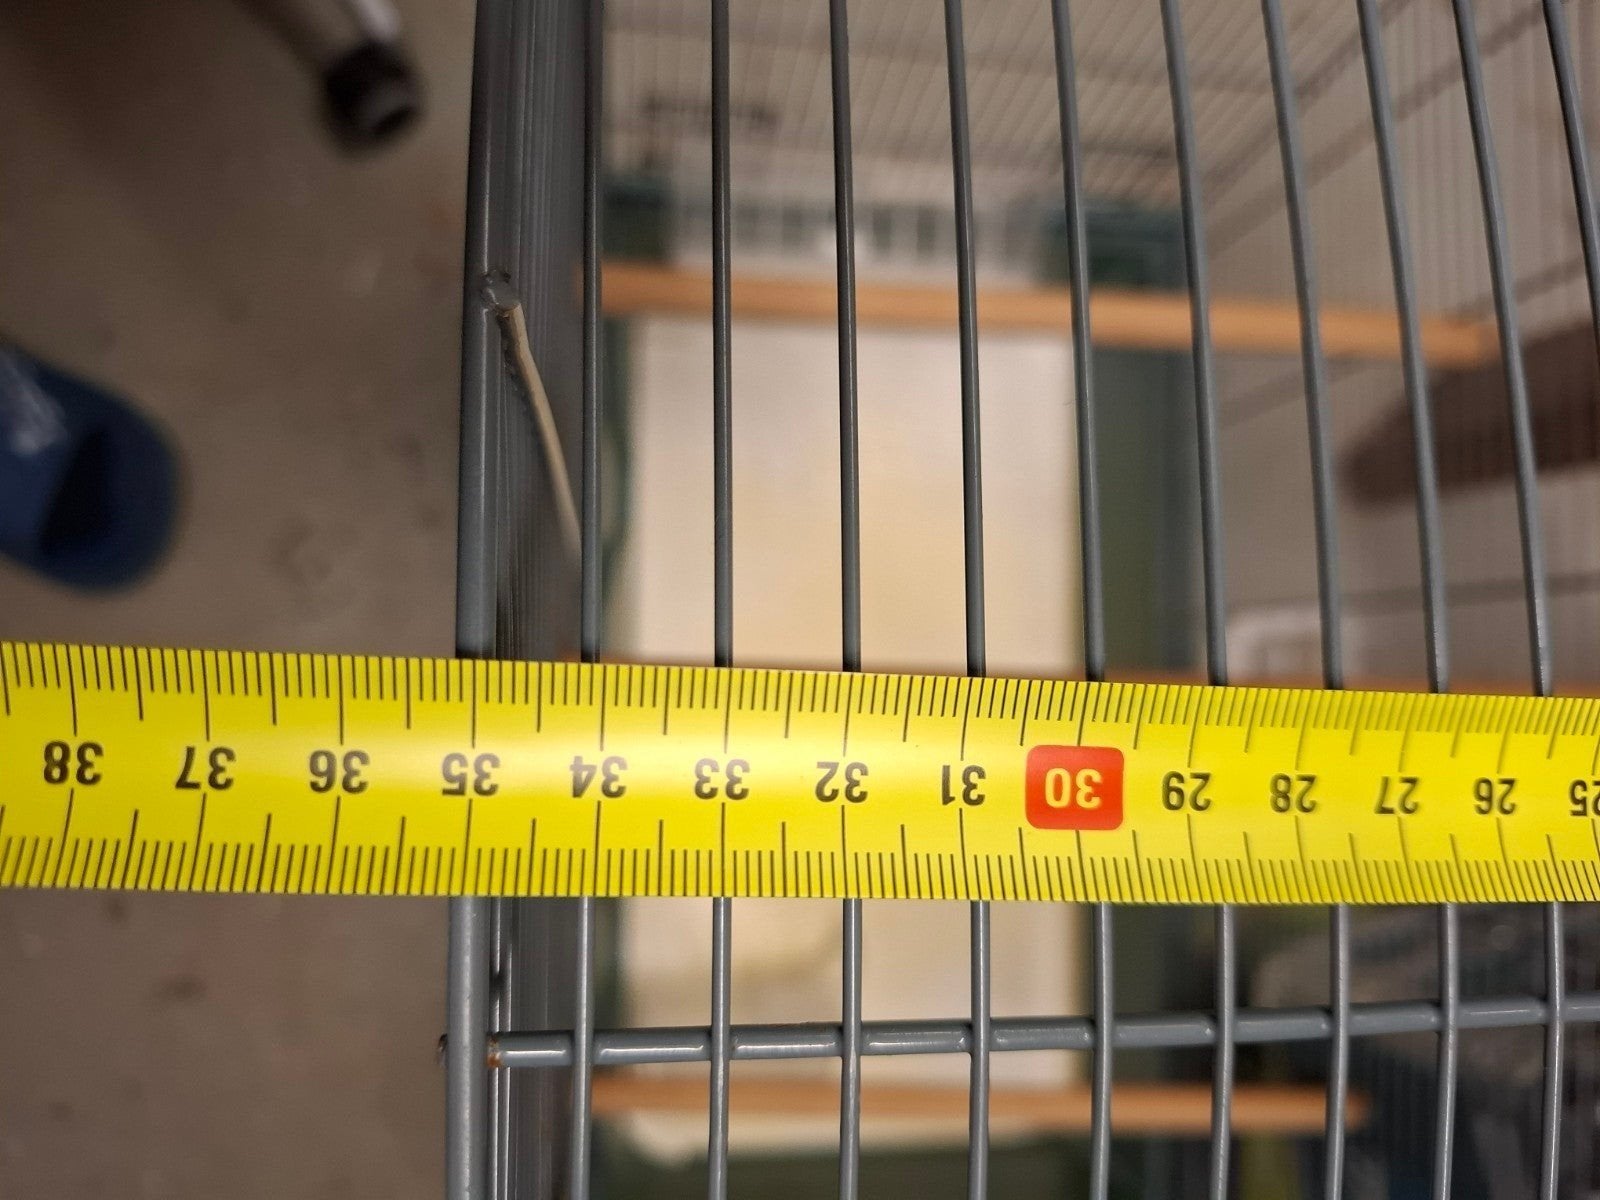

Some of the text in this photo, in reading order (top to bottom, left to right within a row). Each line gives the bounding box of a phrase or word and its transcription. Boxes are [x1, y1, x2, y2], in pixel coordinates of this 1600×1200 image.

[43, 741, 103, 786] 38
[175, 746, 236, 791] 37
[309, 750, 369, 793] 36
[441, 752, 500, 797] 35
[570, 755, 627, 798] 34
[694, 758, 750, 800] 33
[815, 761, 868, 803] 32
[941, 764, 986, 806] 31
[1044, 768, 1102, 809] 30
[1163, 772, 1212, 812] 29
[1270, 773, 1317, 814] 28
[1374, 776, 1419, 815] 27
[1474, 778, 1516, 815] 26
